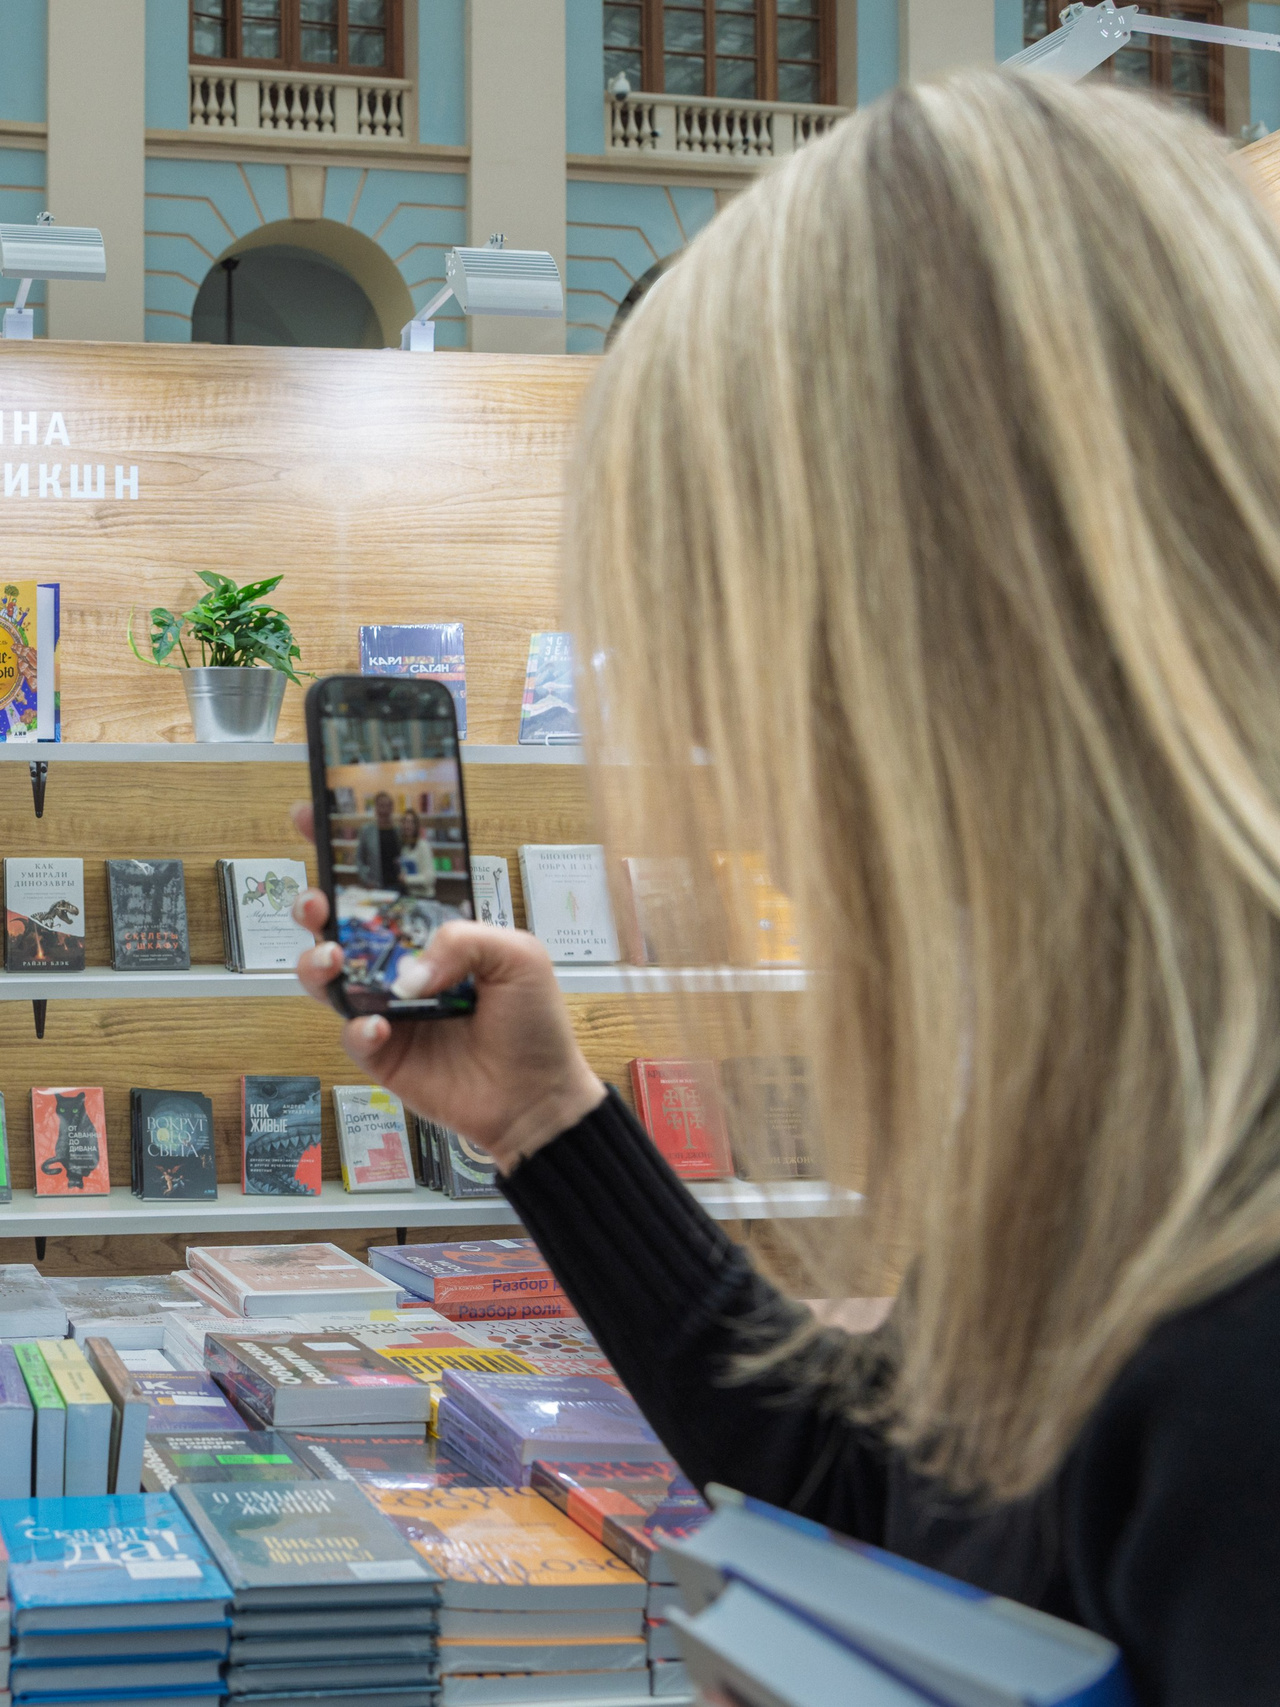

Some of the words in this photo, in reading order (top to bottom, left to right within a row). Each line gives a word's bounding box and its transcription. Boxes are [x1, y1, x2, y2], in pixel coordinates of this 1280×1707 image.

[369, 656, 402, 666] КАРЛ
[410, 664, 449, 673] САГАН
[540, 853, 592, 861] БИОЛОГИЯ
[14, 880, 75, 888] ДИНОЗАВРЫ
[124, 932, 179, 940] СКЕЛЕТЫ
[137, 942, 179, 950] ШКАФУ
[250, 1103, 269, 1118] КАК
[147, 1116, 208, 1133] ВОКРУГ
[250, 1118, 288, 1133] ЖИВЫЕ
[345, 1112, 380, 1126] Дойти
[147, 1130, 192, 1144] ТОГО
[347, 1125, 361, 1135] до
[147, 1143, 199, 1158] СВЕТА
[492, 1277, 548, 1292] Разбор
[459, 1305, 516, 1320] Разбор
[521, 1304, 561, 1318] роли
[24, 1526, 160, 1544] Сказать
[63, 1530, 189, 1570] Да!
[263, 1535, 360, 1551] Виктор
[267, 1548, 376, 1566] Франкл
